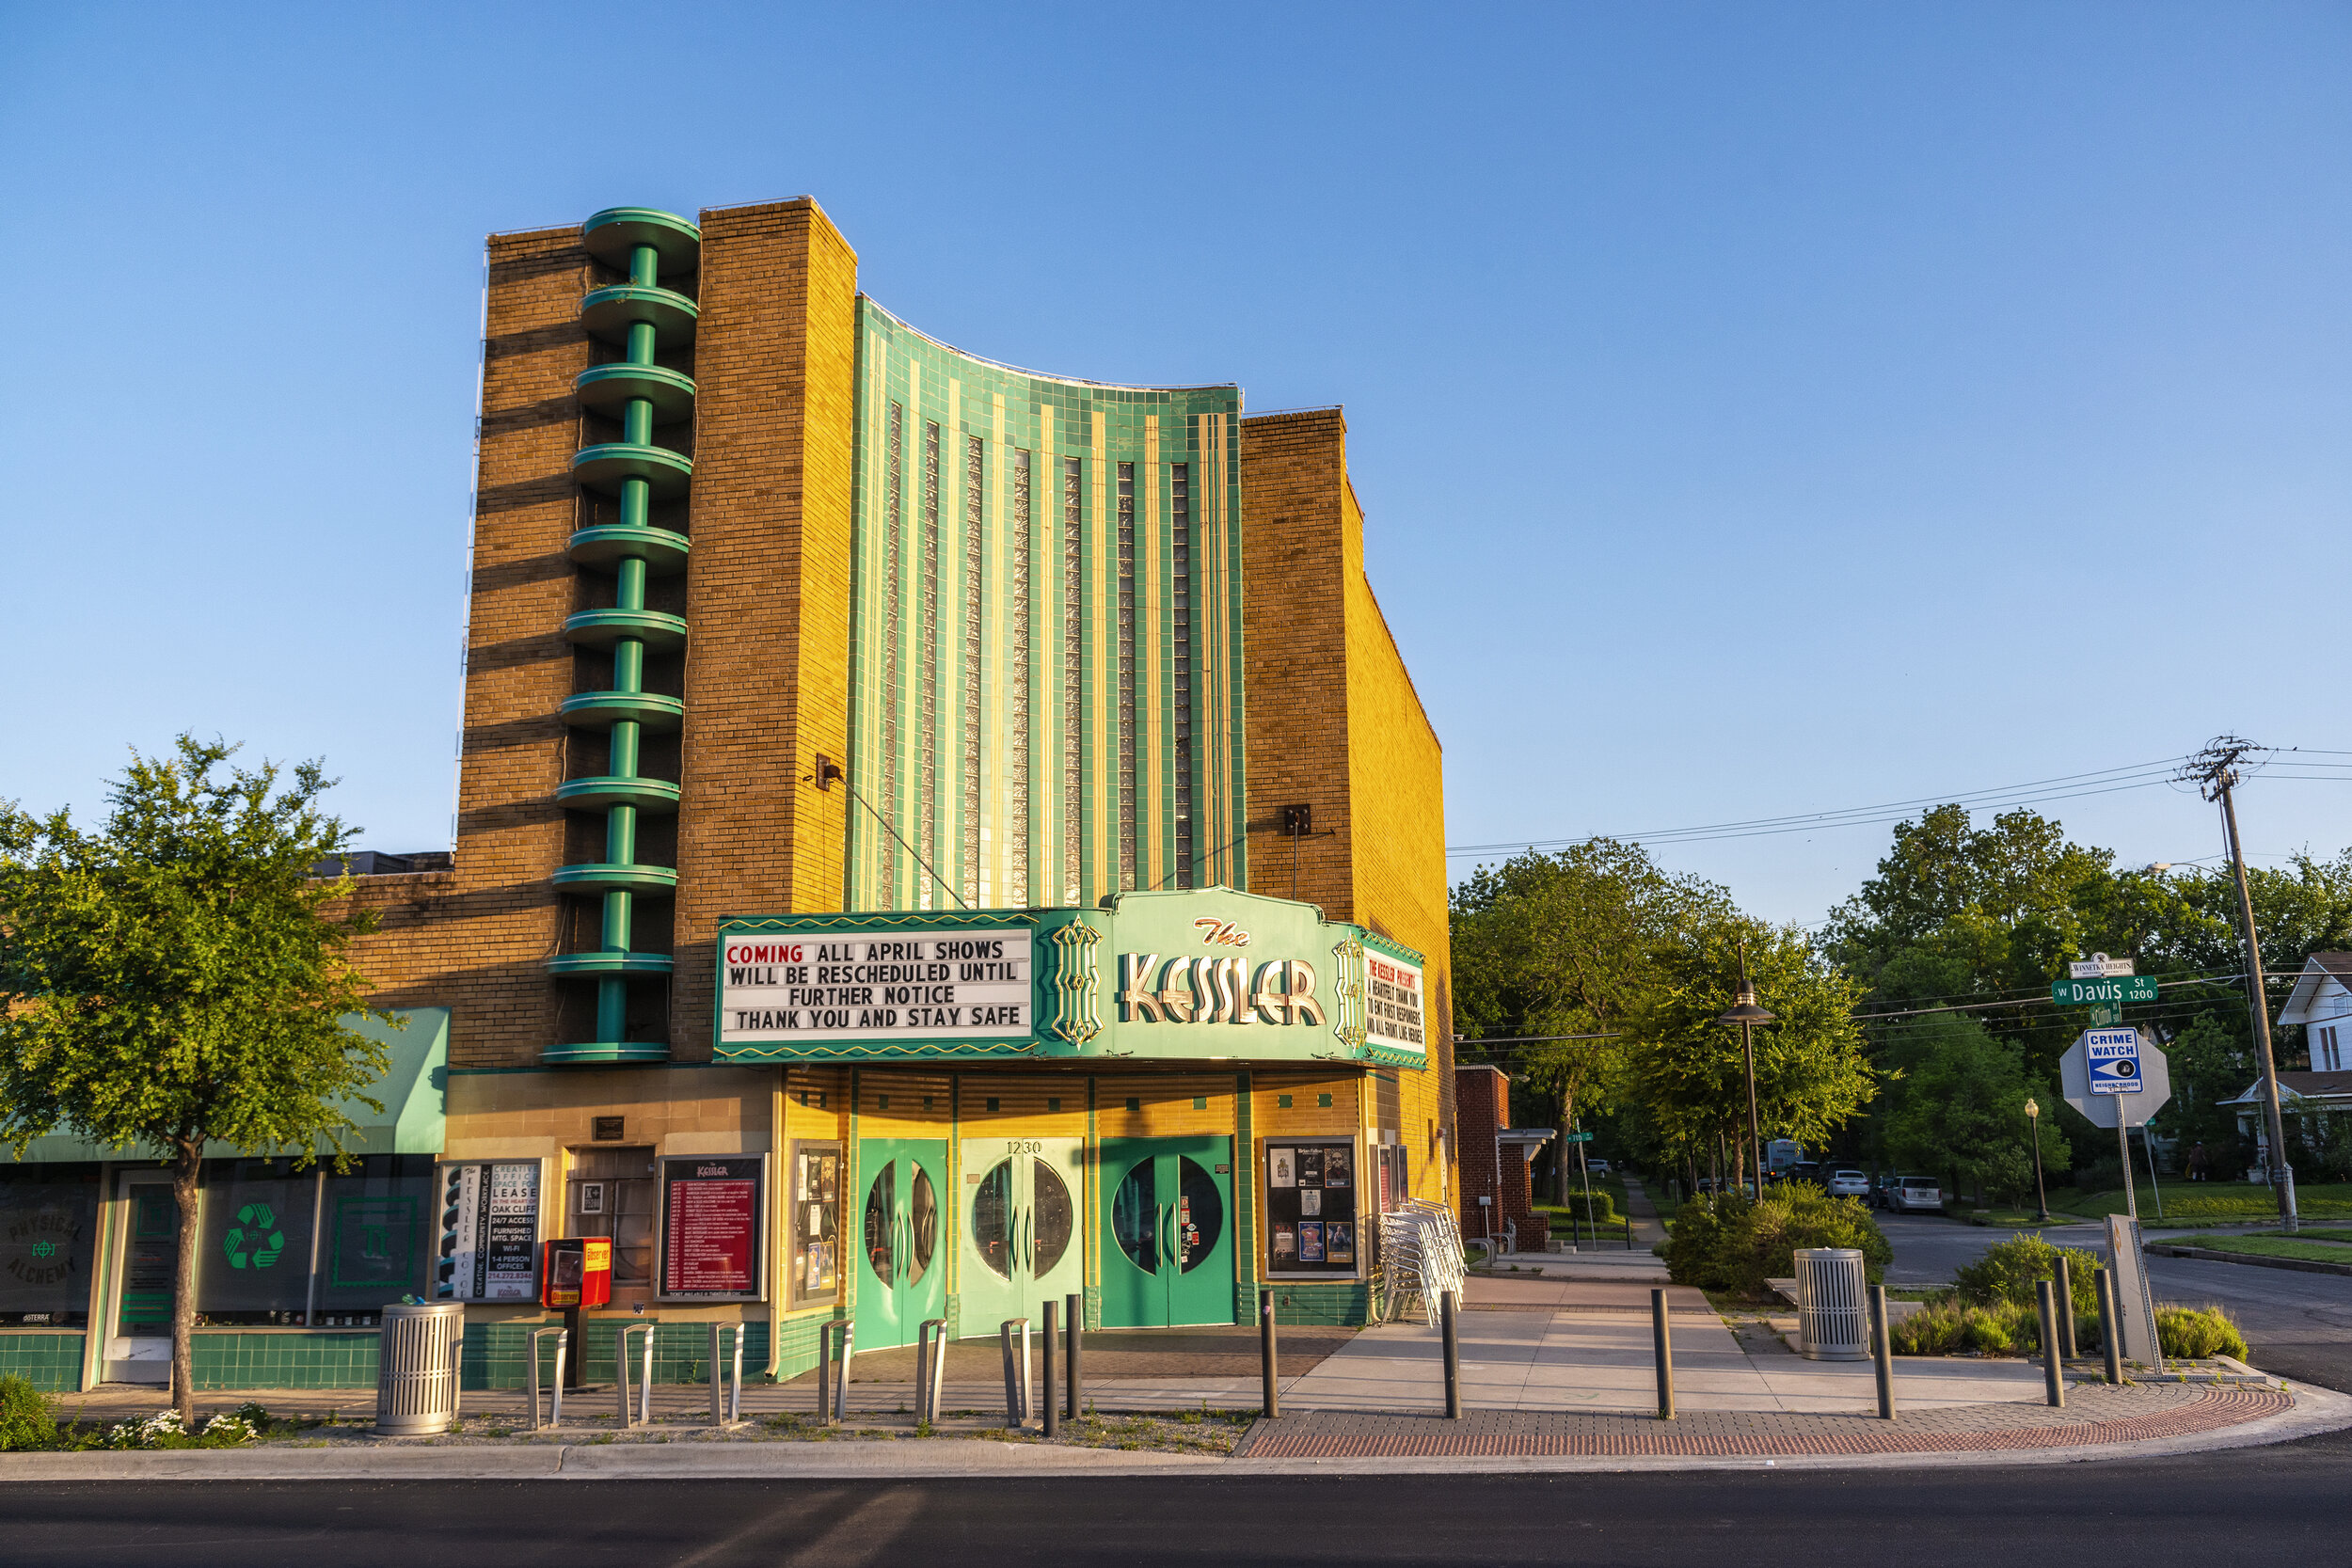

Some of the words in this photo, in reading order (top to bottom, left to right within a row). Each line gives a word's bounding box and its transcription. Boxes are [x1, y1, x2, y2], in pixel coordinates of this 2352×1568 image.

[1193, 917, 1251, 947] The
[726, 944, 803, 964] COMING
[817, 943, 854, 962] ALL
[866, 942, 924, 961] APRIL
[935, 941, 1004, 959] SHOWS
[730, 966, 777, 985] WILL
[786, 966, 808, 985] BE
[818, 963, 951, 984] RESCHEDULED
[960, 962, 1017, 981] UNTIL
[1369, 958, 1377, 977] THE
[1377, 962, 1394, 983] KESSLER
[1397, 969, 1416, 990] PRESENTS
[2073, 963, 2105, 972] WINNETKA
[2106, 961, 2132, 970] HEIGHTS
[789, 987, 874, 1006] FURTHER
[884, 985, 955, 1005] NOTICE
[1120, 952, 1327, 1026] KESSLER
[1372, 979, 1394, 1002] HEARTFELT
[1395, 987, 1408, 1005] THANK
[1409, 991, 1418, 1008] YOU
[2058, 988, 2068, 997] W
[2072, 980, 2122, 1002] Davis
[2135, 978, 2145, 988] St
[2129, 990, 2153, 1000] 1200
[737, 1010, 800, 1029] THANK
[809, 1009, 850, 1028] YOU
[859, 1007, 898, 1027] AND
[908, 1007, 961, 1026] STAY
[971, 1006, 1020, 1025] SAFE
[1368, 997, 1374, 1015] TO
[1384, 1002, 1395, 1020] FIRST
[1396, 1006, 1421, 1026] RESPONDERS
[1375, 1019, 1385, 1037] ALL
[1385, 1021, 1398, 1038] FRONT
[1399, 1025, 1407, 1041] LINE
[1408, 1027, 1423, 1044] HEROES
[2090, 1035, 2133, 1045] CRIME
[2091, 1046, 2134, 1056] WATCH
[1008, 1141, 1042, 1154] 1230
[697, 1166, 729, 1178] KESSLER
[493, 1188, 536, 1197] LEASE
[8, 1214, 83, 1242] PHYSICAL
[8, 1256, 75, 1285] ALCHEMY
